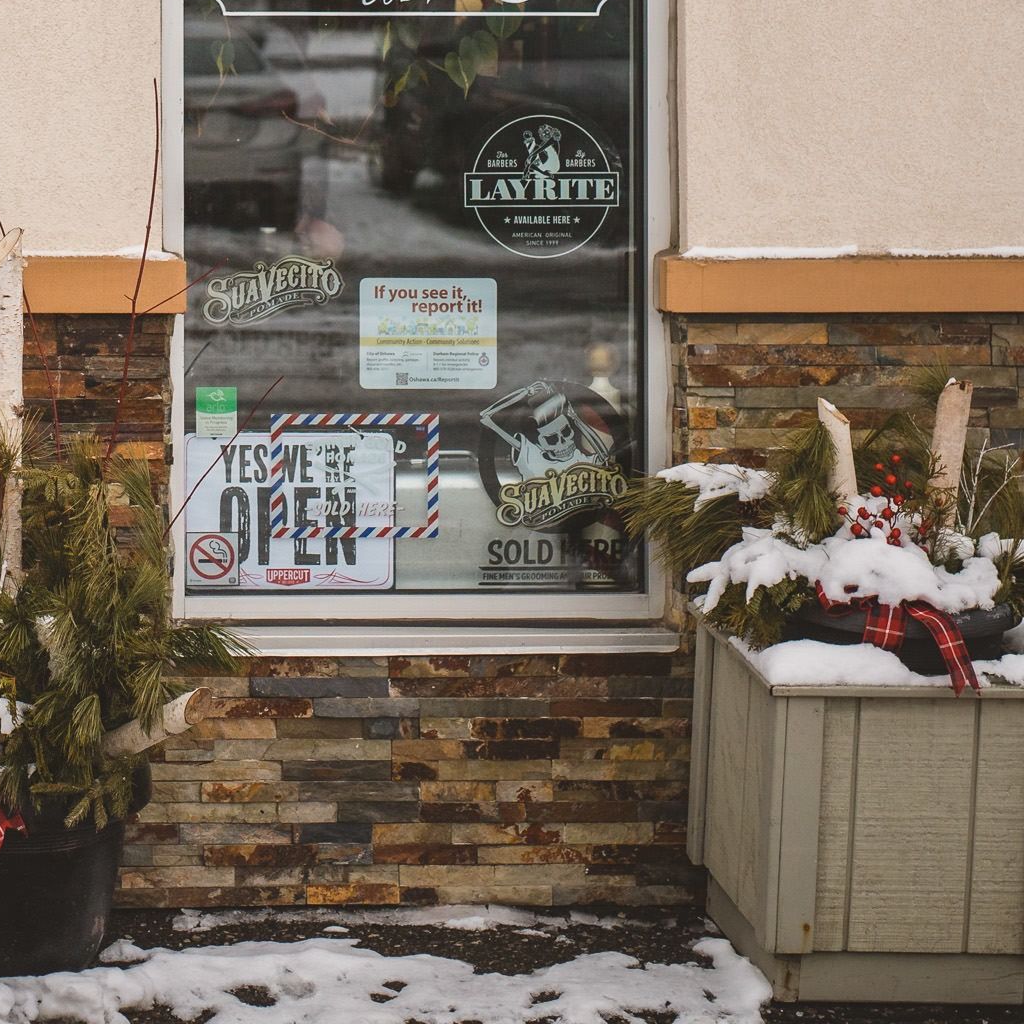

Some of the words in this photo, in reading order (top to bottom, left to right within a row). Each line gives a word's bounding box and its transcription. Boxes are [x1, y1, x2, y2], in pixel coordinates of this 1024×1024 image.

[487, 159, 518, 168] BARBERS
[565, 159, 596, 168] BARBERS
[469, 178, 615, 201] LAYRITE
[513, 215, 551, 225] AVAILABLE
[552, 215, 571, 225] HERE
[374, 285, 386, 299] If
[389, 289, 418, 302] you
[422, 289, 448, 299] see
[452, 285, 467, 301] it,
[249, 292, 300, 317] POMADE
[412, 301, 464, 316] report
[466, 299, 483, 313] it!
[220, 444, 269, 483] YES
[220, 486, 357, 565] OPEN
[487, 539, 554, 565] SOLD
[267, 570, 309, 582] UPPERCUT
